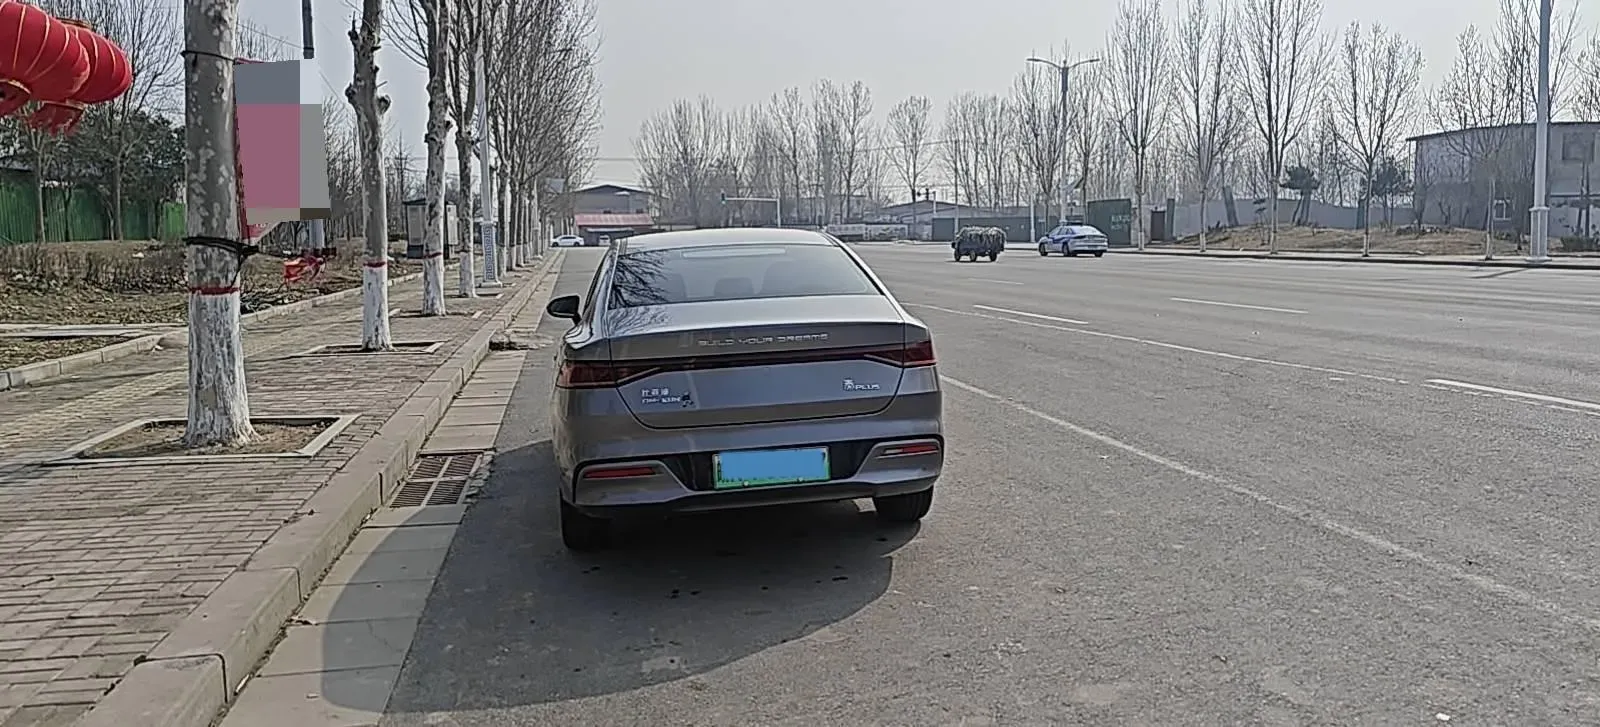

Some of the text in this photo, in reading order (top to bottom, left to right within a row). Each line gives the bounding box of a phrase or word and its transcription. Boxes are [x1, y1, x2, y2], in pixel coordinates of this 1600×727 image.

[698, 333, 828, 347] BUILD YOUR DREAMS
